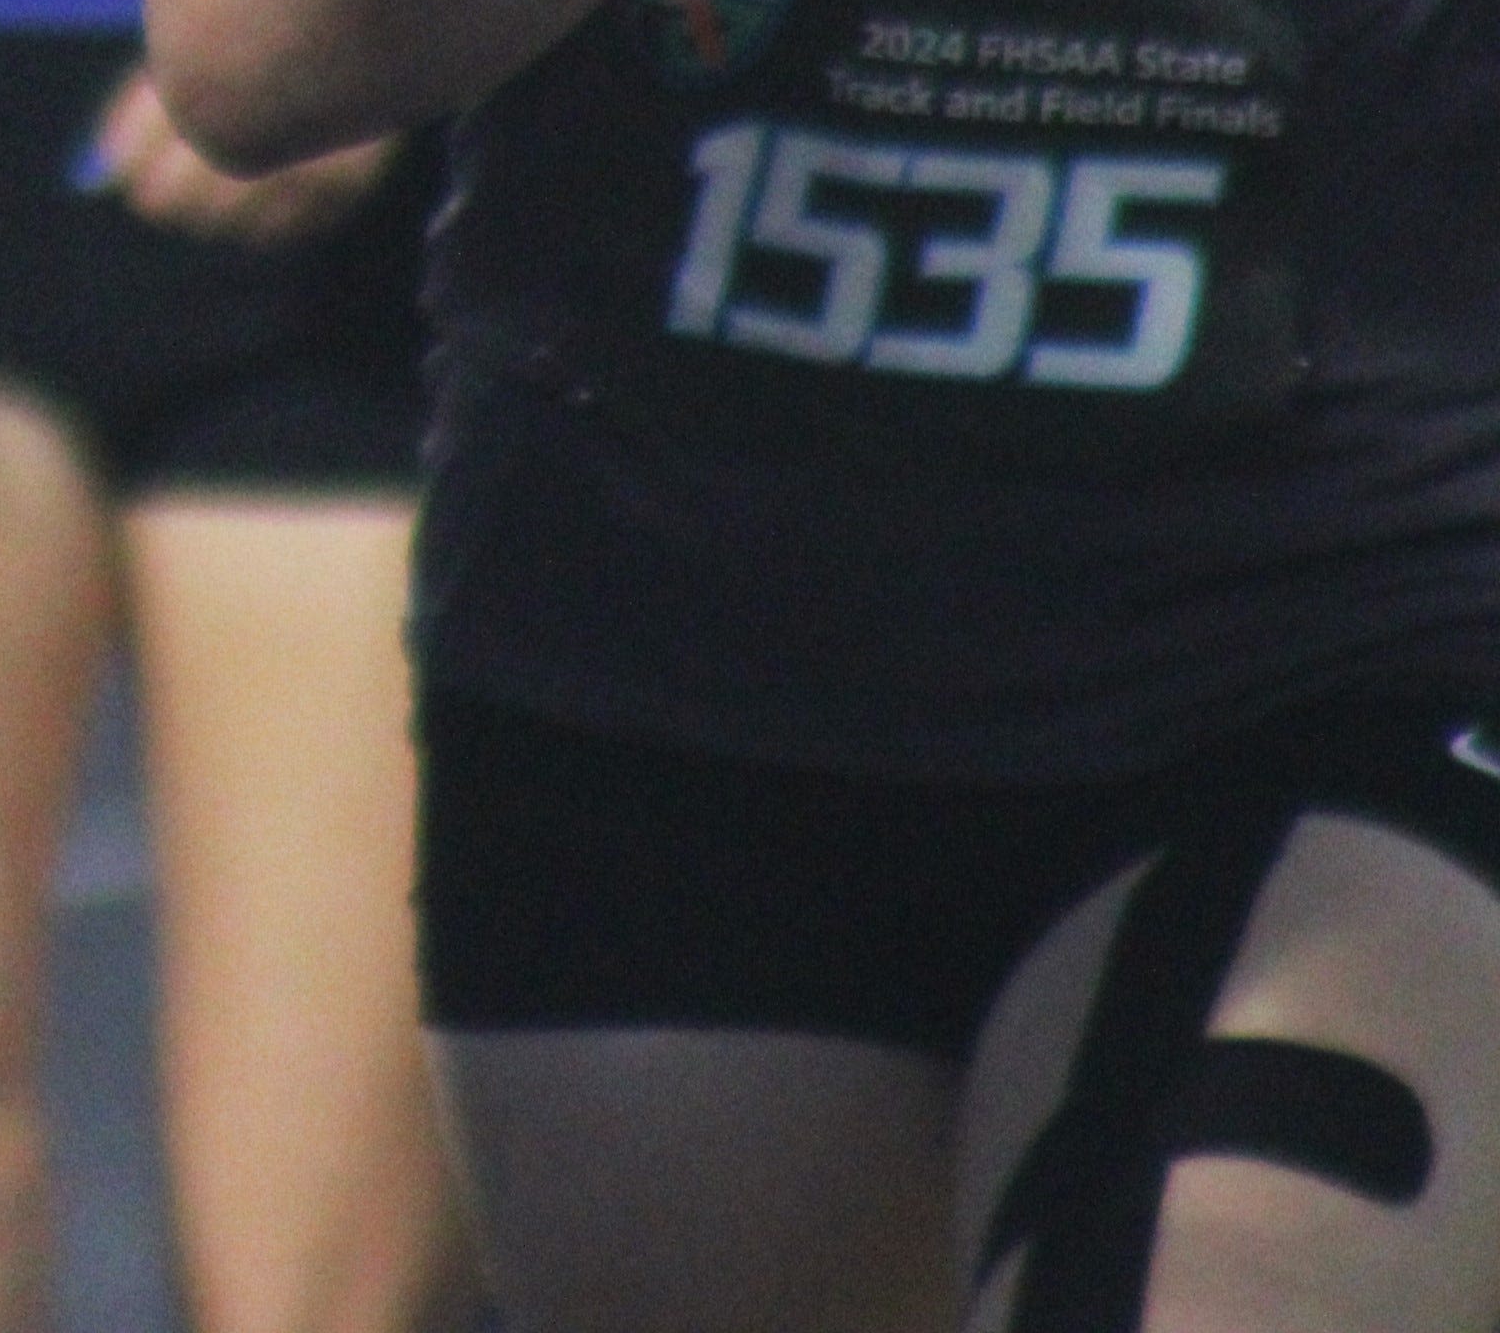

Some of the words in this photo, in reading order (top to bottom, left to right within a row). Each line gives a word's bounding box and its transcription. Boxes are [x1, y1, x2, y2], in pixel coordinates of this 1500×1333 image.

[863, 22, 964, 66] 2024
[977, 32, 1120, 76] FHSAA
[1136, 41, 1248, 86] State
[828, 64, 932, 116] Track
[945, 83, 1026, 122] and
[1041, 86, 1143, 126] Field
[1157, 93, 1281, 138] Finals
[666, 127, 1231, 394] 1535
